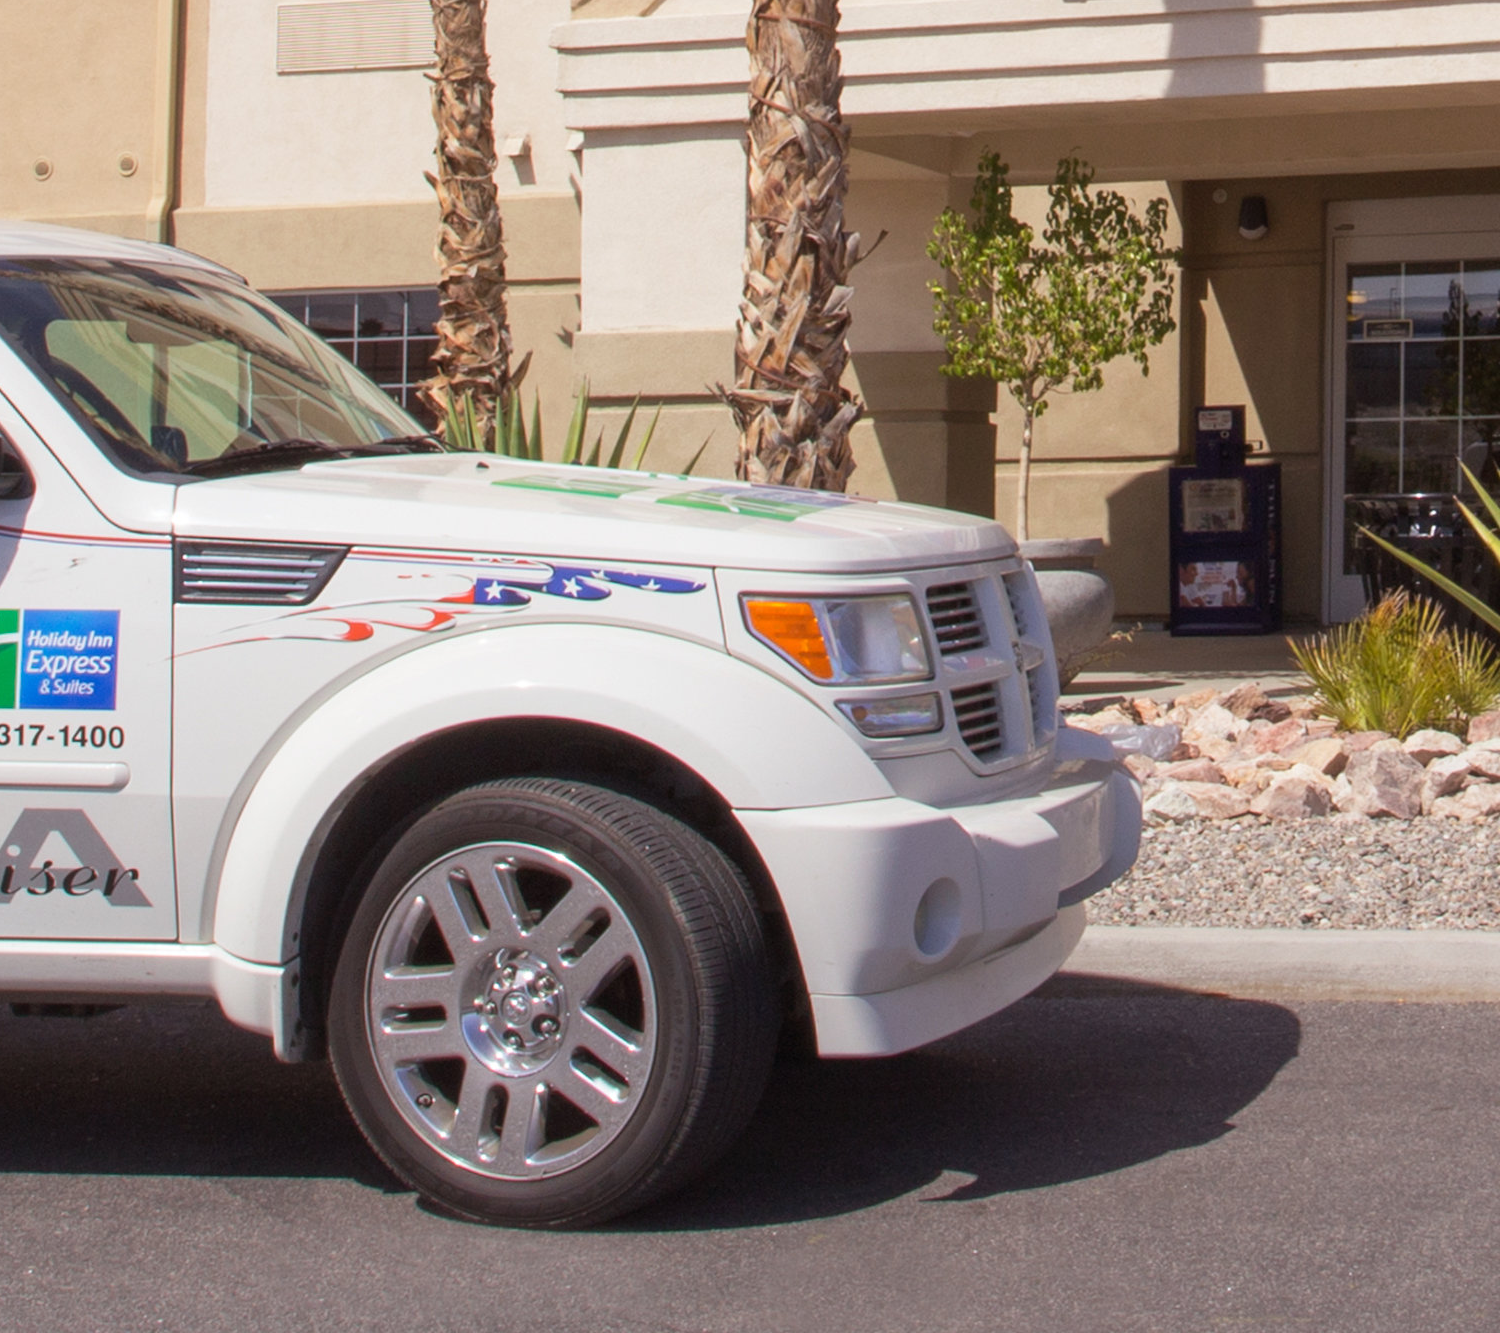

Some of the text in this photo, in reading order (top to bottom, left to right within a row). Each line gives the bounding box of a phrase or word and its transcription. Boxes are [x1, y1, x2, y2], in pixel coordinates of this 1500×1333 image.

[27, 630, 113, 651] Holiday Inn
[26, 650, 112, 679] Express
[39, 678, 95, 695] & Suites
